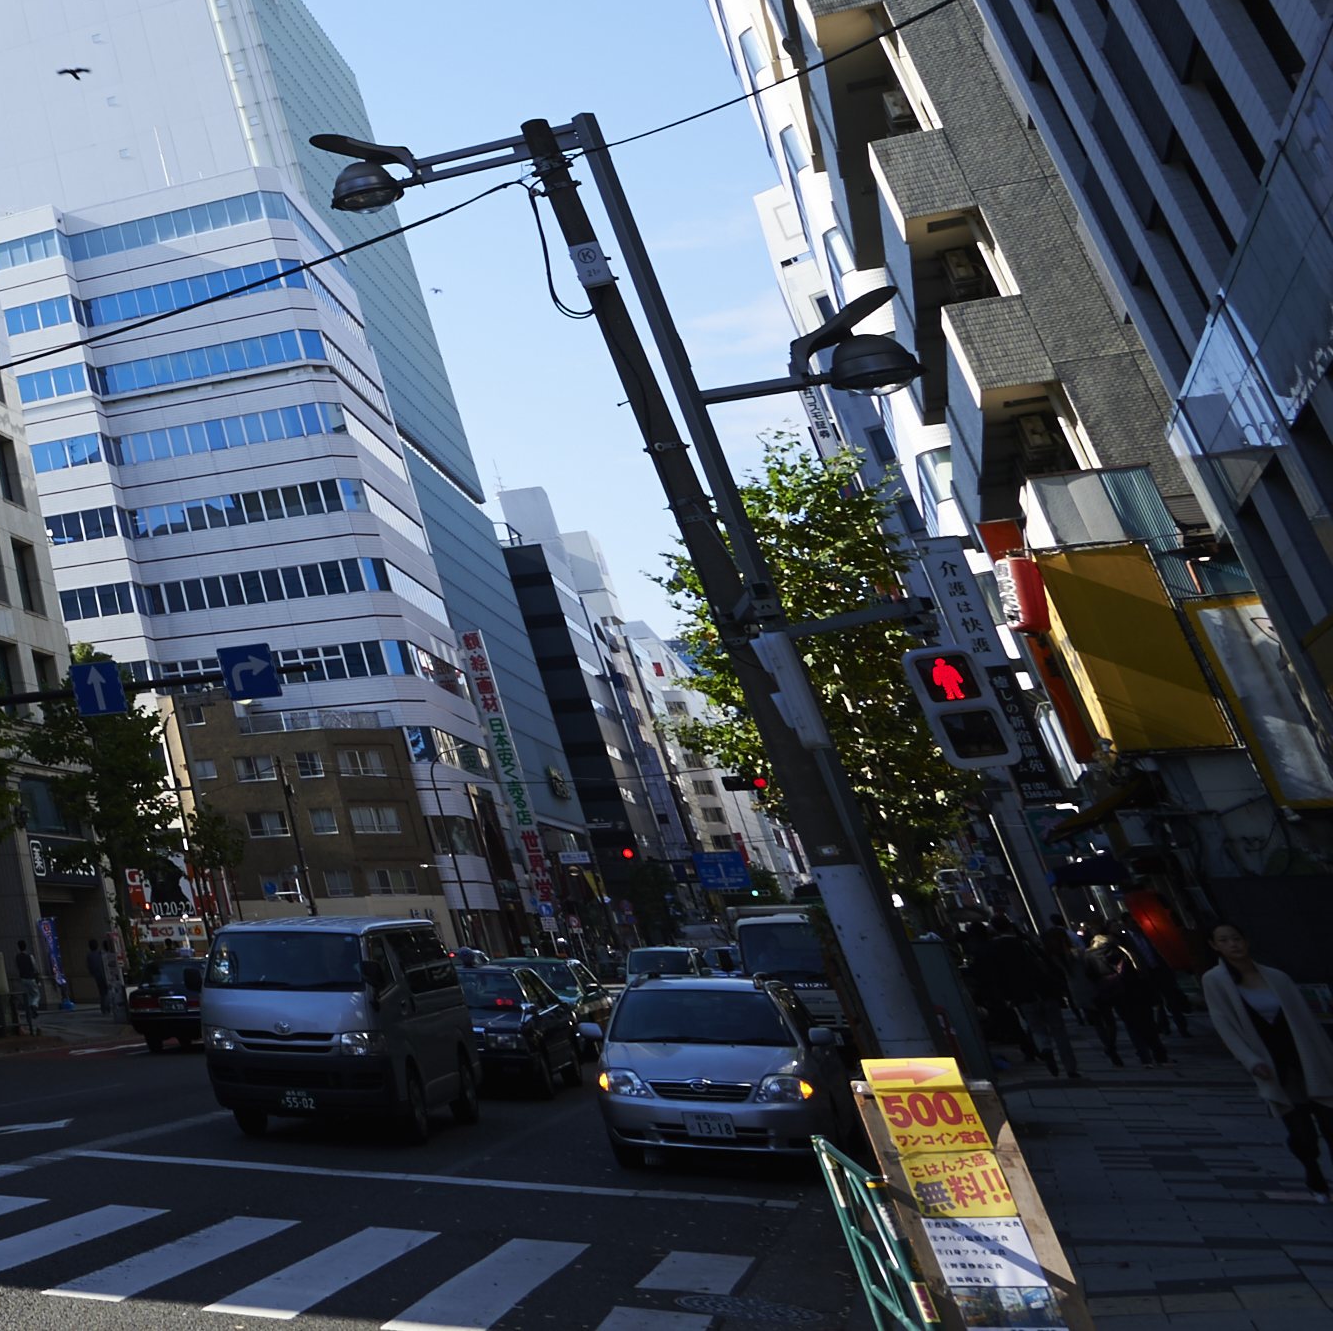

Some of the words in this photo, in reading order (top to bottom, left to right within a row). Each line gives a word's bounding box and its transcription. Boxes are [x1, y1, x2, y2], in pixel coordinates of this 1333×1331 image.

[939, 560, 992, 653] 介護は快護
[521, 830, 552, 901] 世界堂
[286, 1097, 315, 1109] 55-02
[882, 1091, 978, 1129] 500円
[697, 1122, 733, 1135] 13-18
[895, 1130, 988, 1148] ワンコイン定食
[909, 1153, 989, 1179] ごはん大盛
[914, 1167, 1012, 1215] 無料!!
